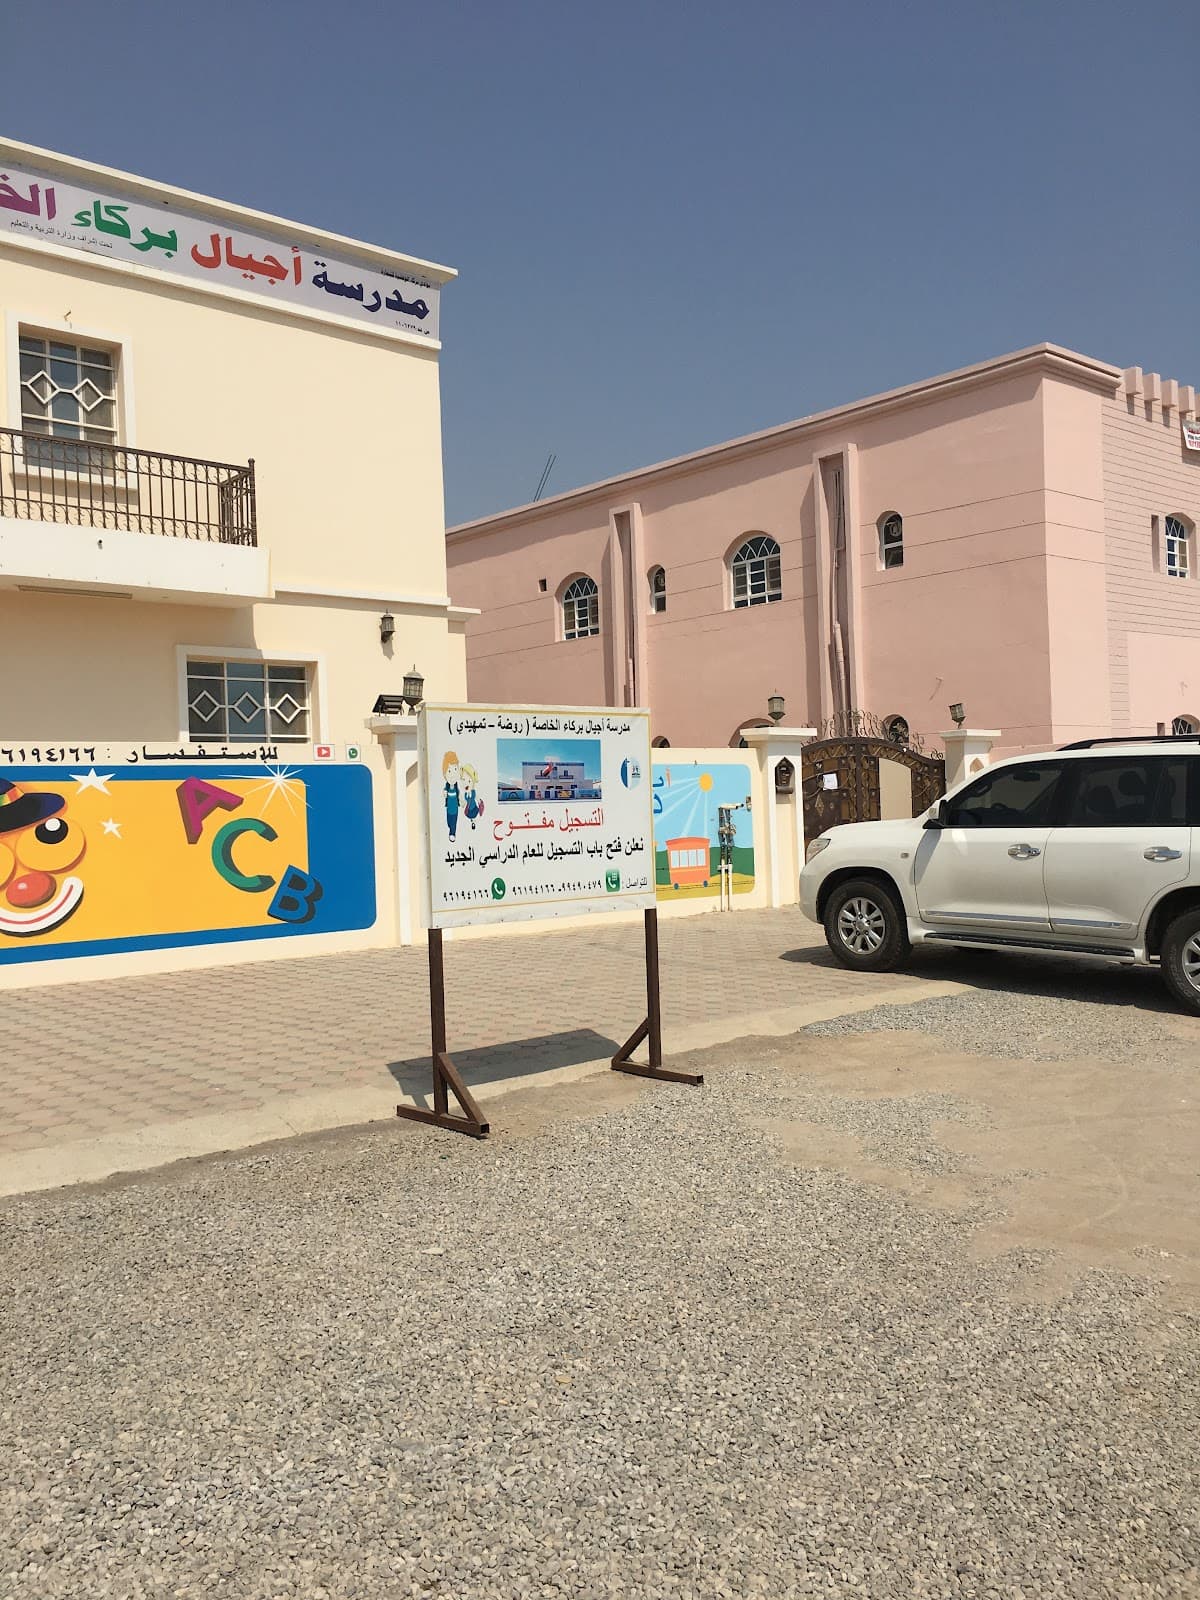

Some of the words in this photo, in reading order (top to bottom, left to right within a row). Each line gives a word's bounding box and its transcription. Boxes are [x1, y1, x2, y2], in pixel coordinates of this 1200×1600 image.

[10, 219, 34, 232] والتعليم
[35, 223, 55, 235] التربية
[57, 229, 76, 241] وزارة
[71, 200, 178, 259] بركاء
[191, 233, 302, 286] أجيال
[311, 260, 430, 320] مدرسة
[456, 717, 487, 735] تمهيدي
[497, 715, 523, 734] روضة
[532, 716, 560, 731] الخاصة
[563, 719, 584, 735] بركاء
[586, 718, 605, 735] أجيال
[606, 718, 631, 735] مدرسة
[493, 810, 555, 841] مفتوح
[559, 808, 604, 833] التسجيل
[522, 842, 543, 865] للعام
[547, 841, 583, 861] التسجيل
[587, 841, 603, 859] باب
[606, 836, 622, 860] فتح
[625, 837, 644, 856] نعلن
[444, 846, 475, 868] الجديد
[479, 844, 518, 869] الدراسي
[626, 876, 648, 889] للتواصل
[443, 889, 489, 902] ٩٦١٩٤١٦٦
